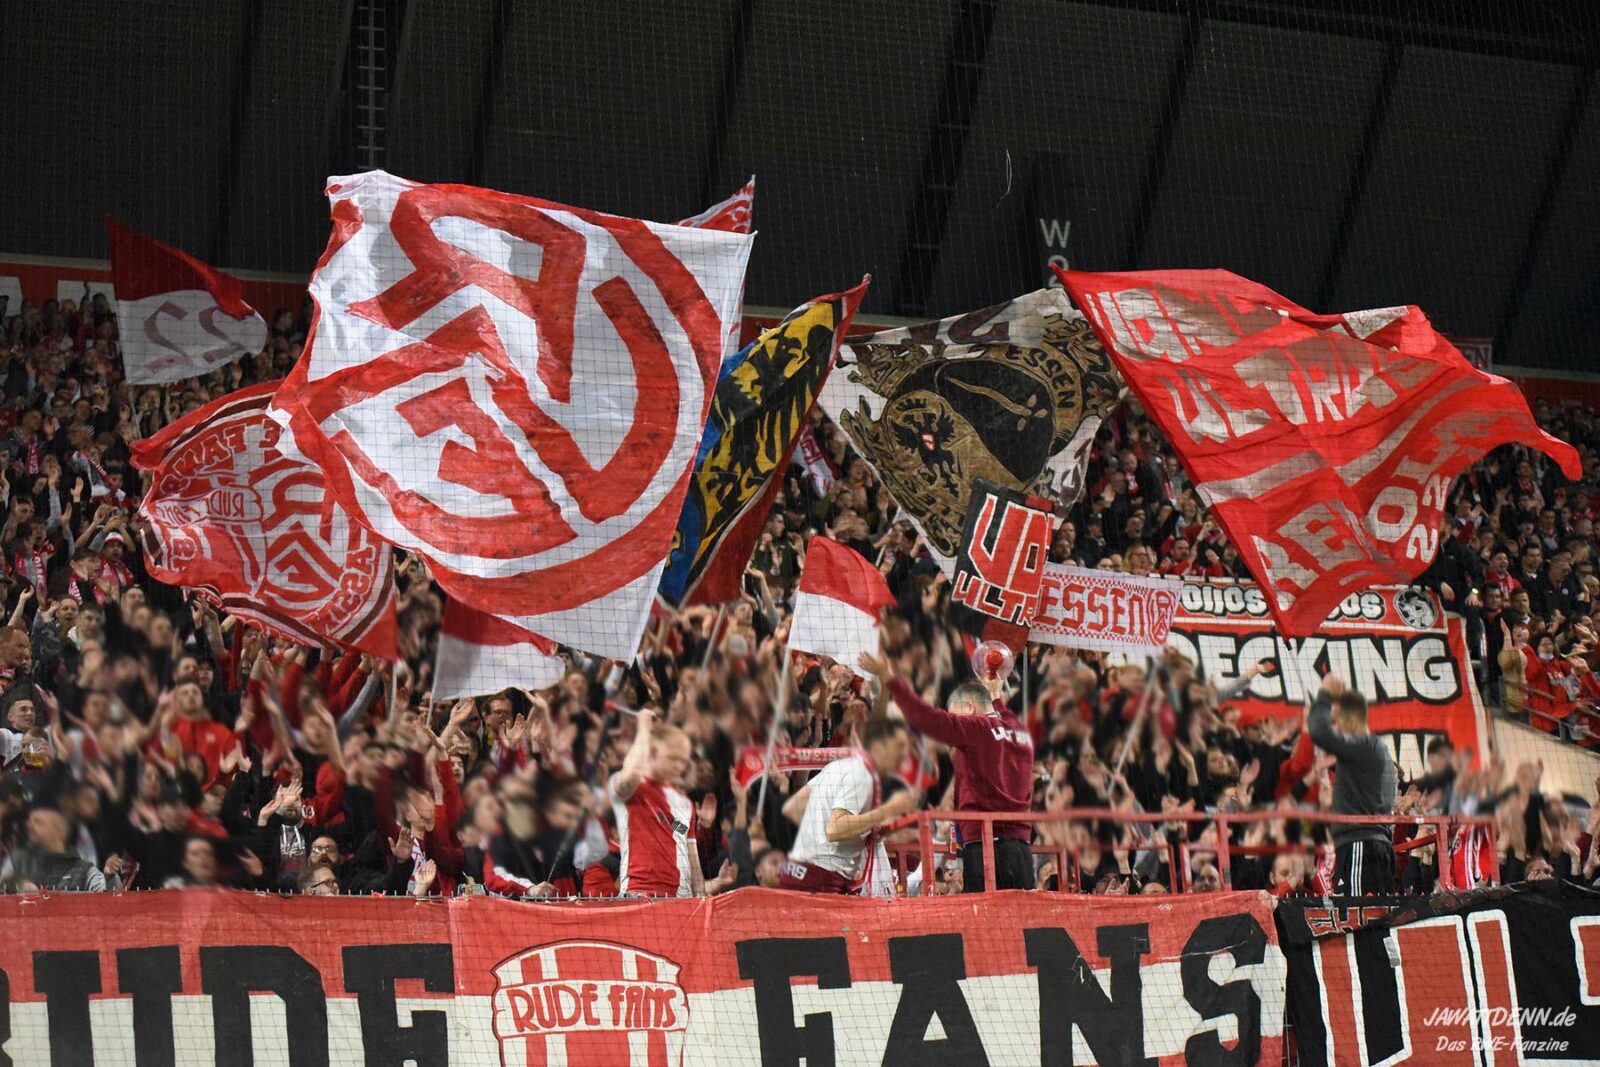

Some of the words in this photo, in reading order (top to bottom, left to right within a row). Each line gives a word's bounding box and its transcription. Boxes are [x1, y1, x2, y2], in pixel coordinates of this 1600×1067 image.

[1040, 218, 1071, 248] W
[952, 571, 1036, 628] ULTR
[0, 943, 455, 1067] UDE
[736, 913, 1268, 1067] FANS
[507, 983, 600, 1032] RUDE
[608, 984, 677, 1027] FANS
